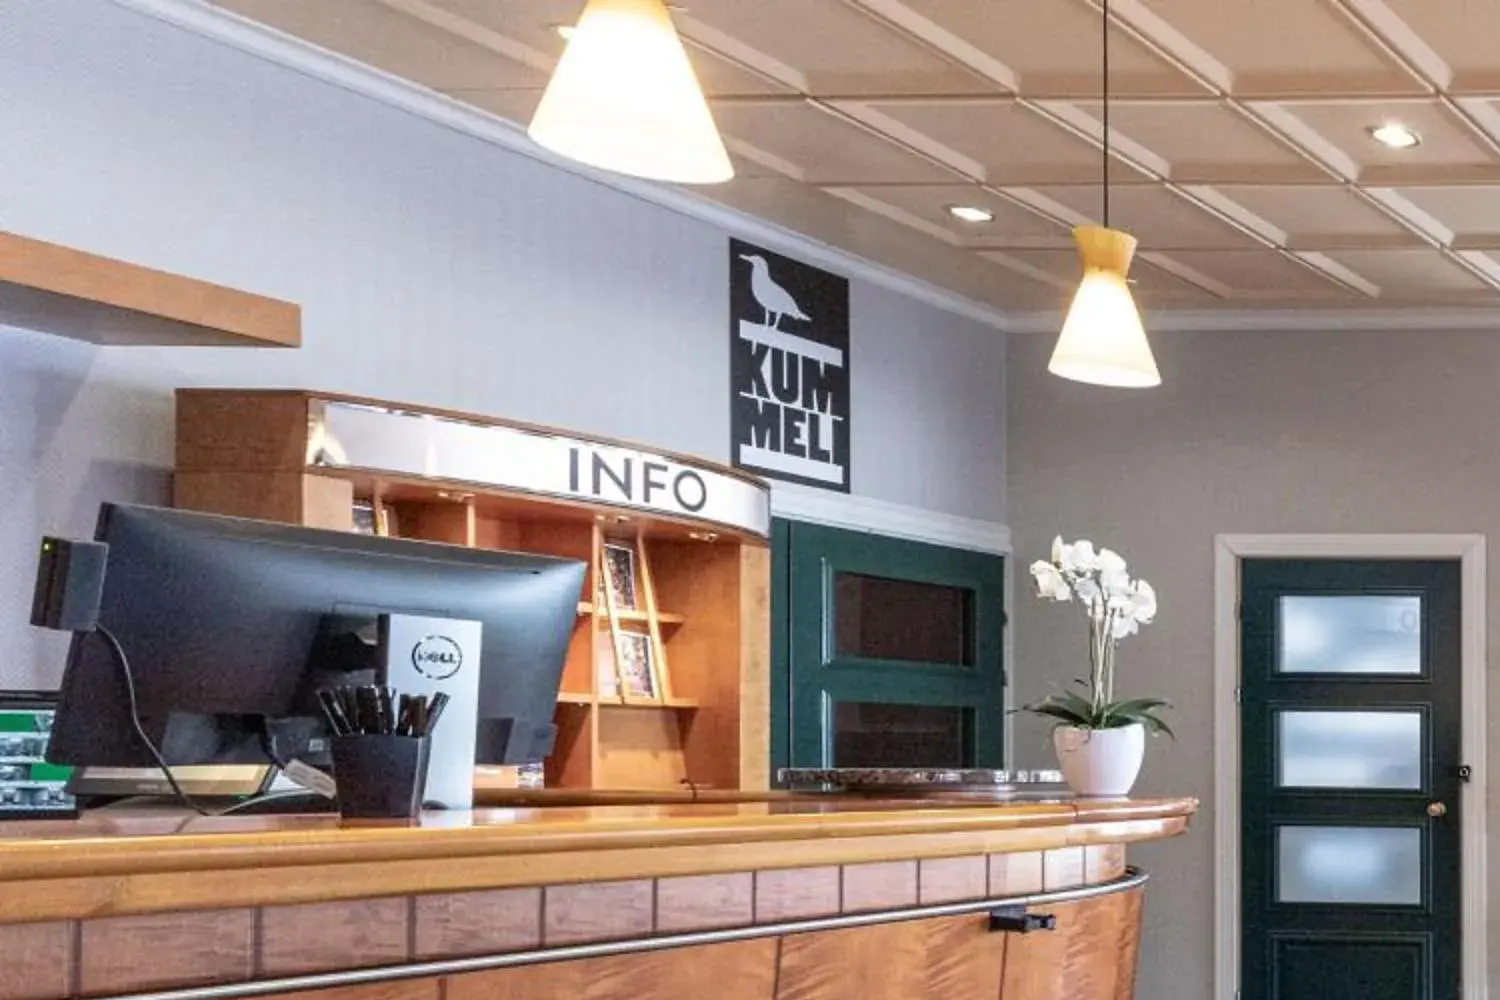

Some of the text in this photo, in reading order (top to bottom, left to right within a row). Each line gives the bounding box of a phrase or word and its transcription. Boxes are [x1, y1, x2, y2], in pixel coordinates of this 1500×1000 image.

[739, 338, 842, 418] KUM
[739, 394, 843, 464] MELI
[569, 448, 707, 512] INFO
